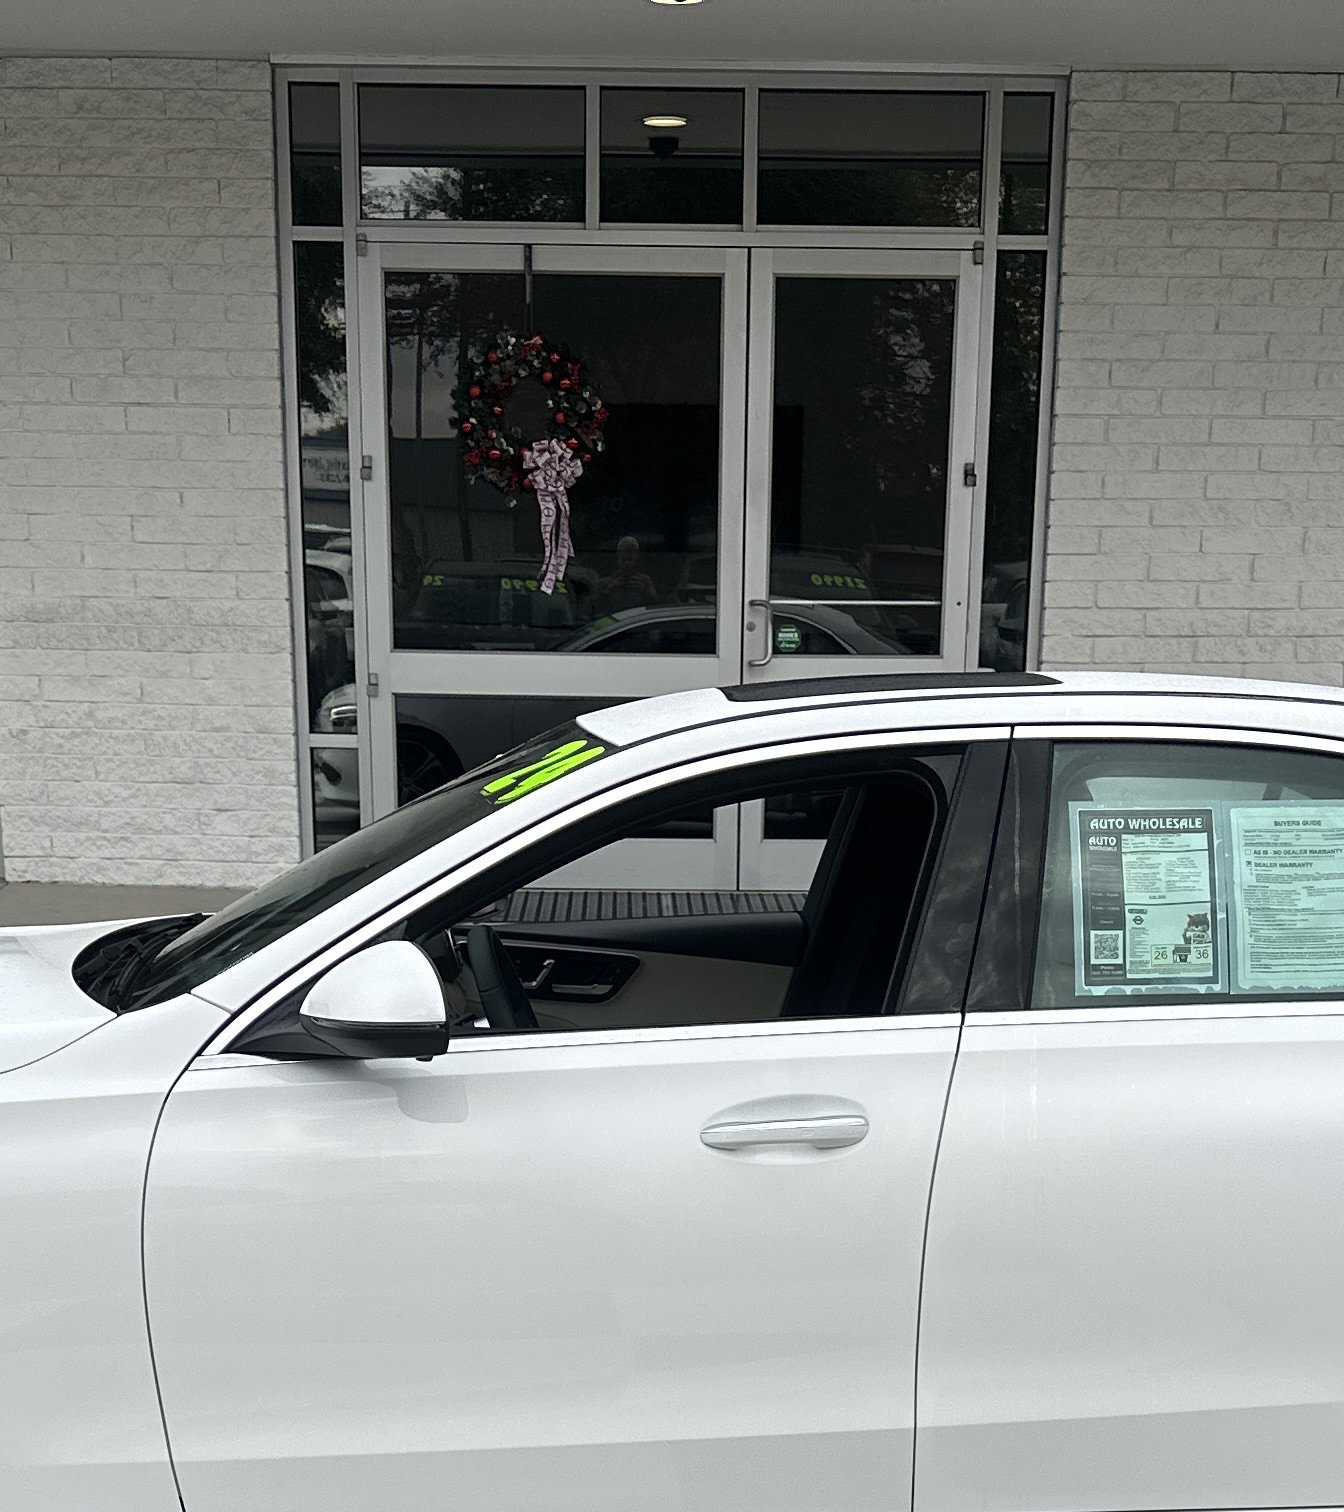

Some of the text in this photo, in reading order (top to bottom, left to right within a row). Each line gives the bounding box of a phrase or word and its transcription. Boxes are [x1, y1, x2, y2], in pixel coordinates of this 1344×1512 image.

[1090, 818, 1203, 830] AUTO WHOLESALE
[1089, 836, 1117, 846] AUTO
[1154, 950, 1168, 960] 26
[1196, 949, 1209, 960] 36
